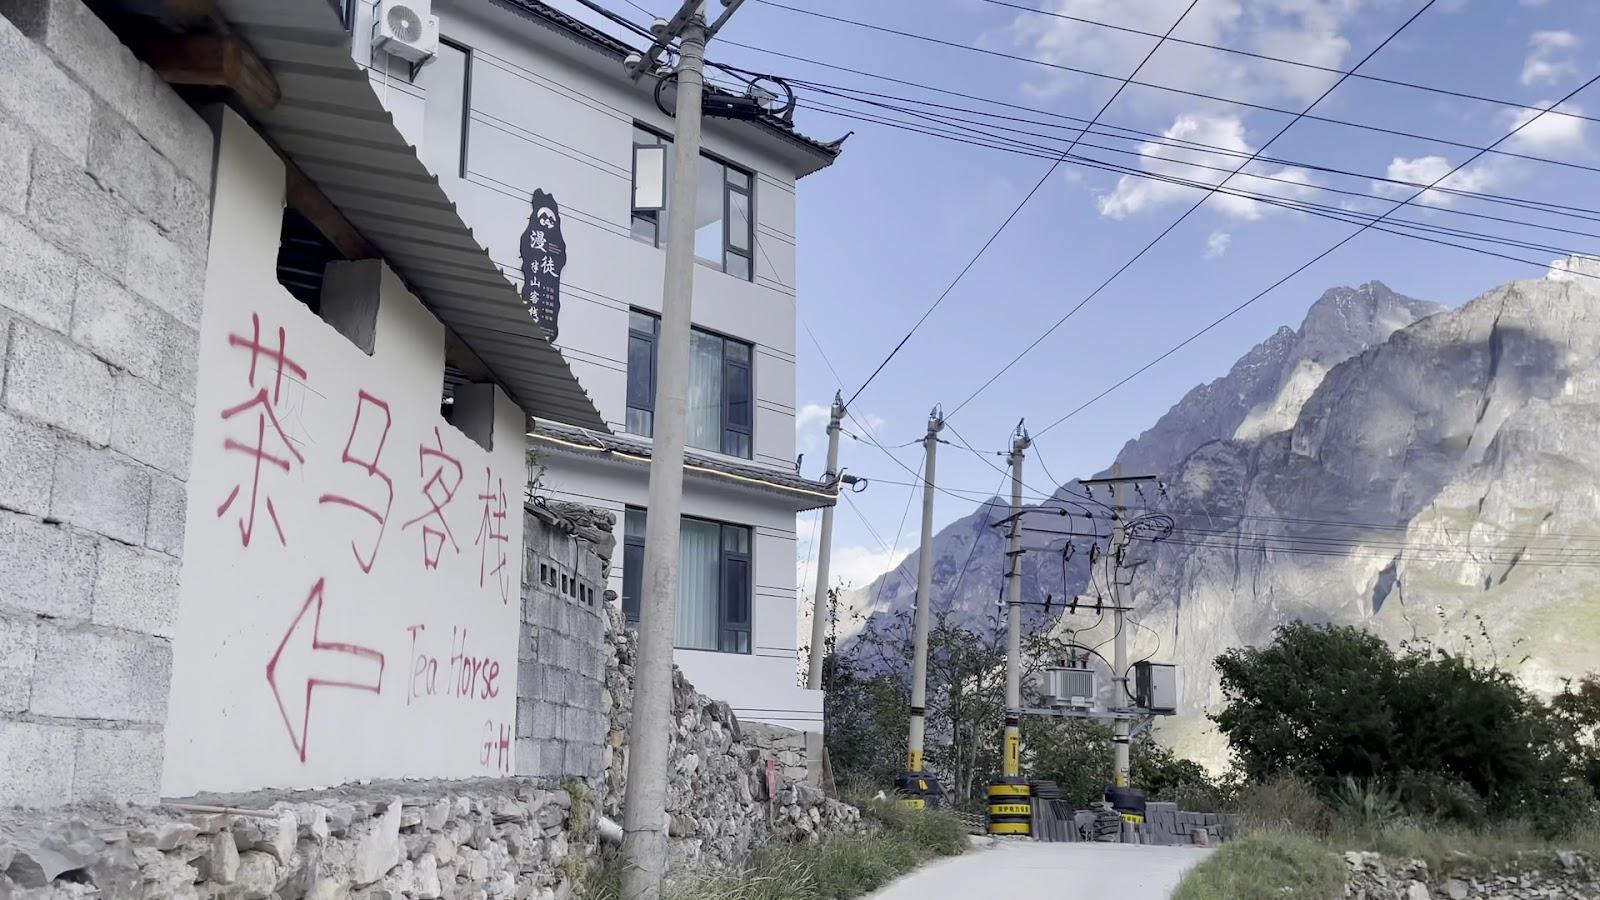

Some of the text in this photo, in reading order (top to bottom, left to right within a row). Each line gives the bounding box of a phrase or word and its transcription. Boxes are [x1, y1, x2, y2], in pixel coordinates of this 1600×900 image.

[530, 230, 559, 277] 漫徒
[217, 312, 509, 605] 茶马客栈
[407, 624, 500, 706] Tea Horse
